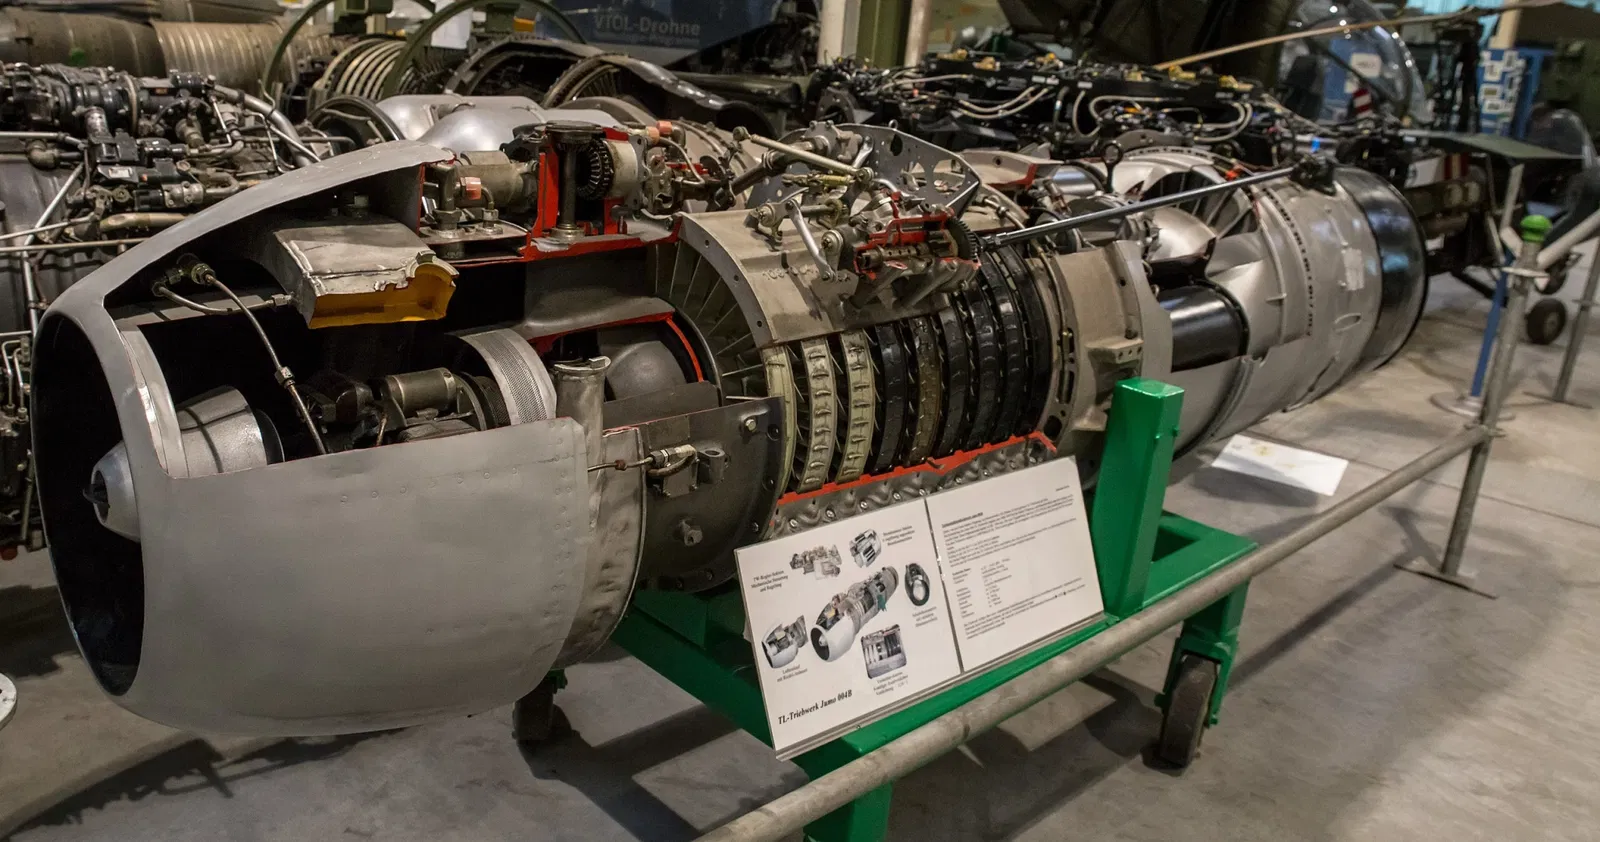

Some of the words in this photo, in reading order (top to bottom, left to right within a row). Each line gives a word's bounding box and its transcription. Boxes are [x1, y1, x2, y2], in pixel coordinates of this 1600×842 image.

[593, 14, 700, 36] VTOL-Drohne
[778, 702, 819, 725] TL-Triebwerk
[820, 697, 837, 709] Jumo
[837, 689, 853, 701] 004B
